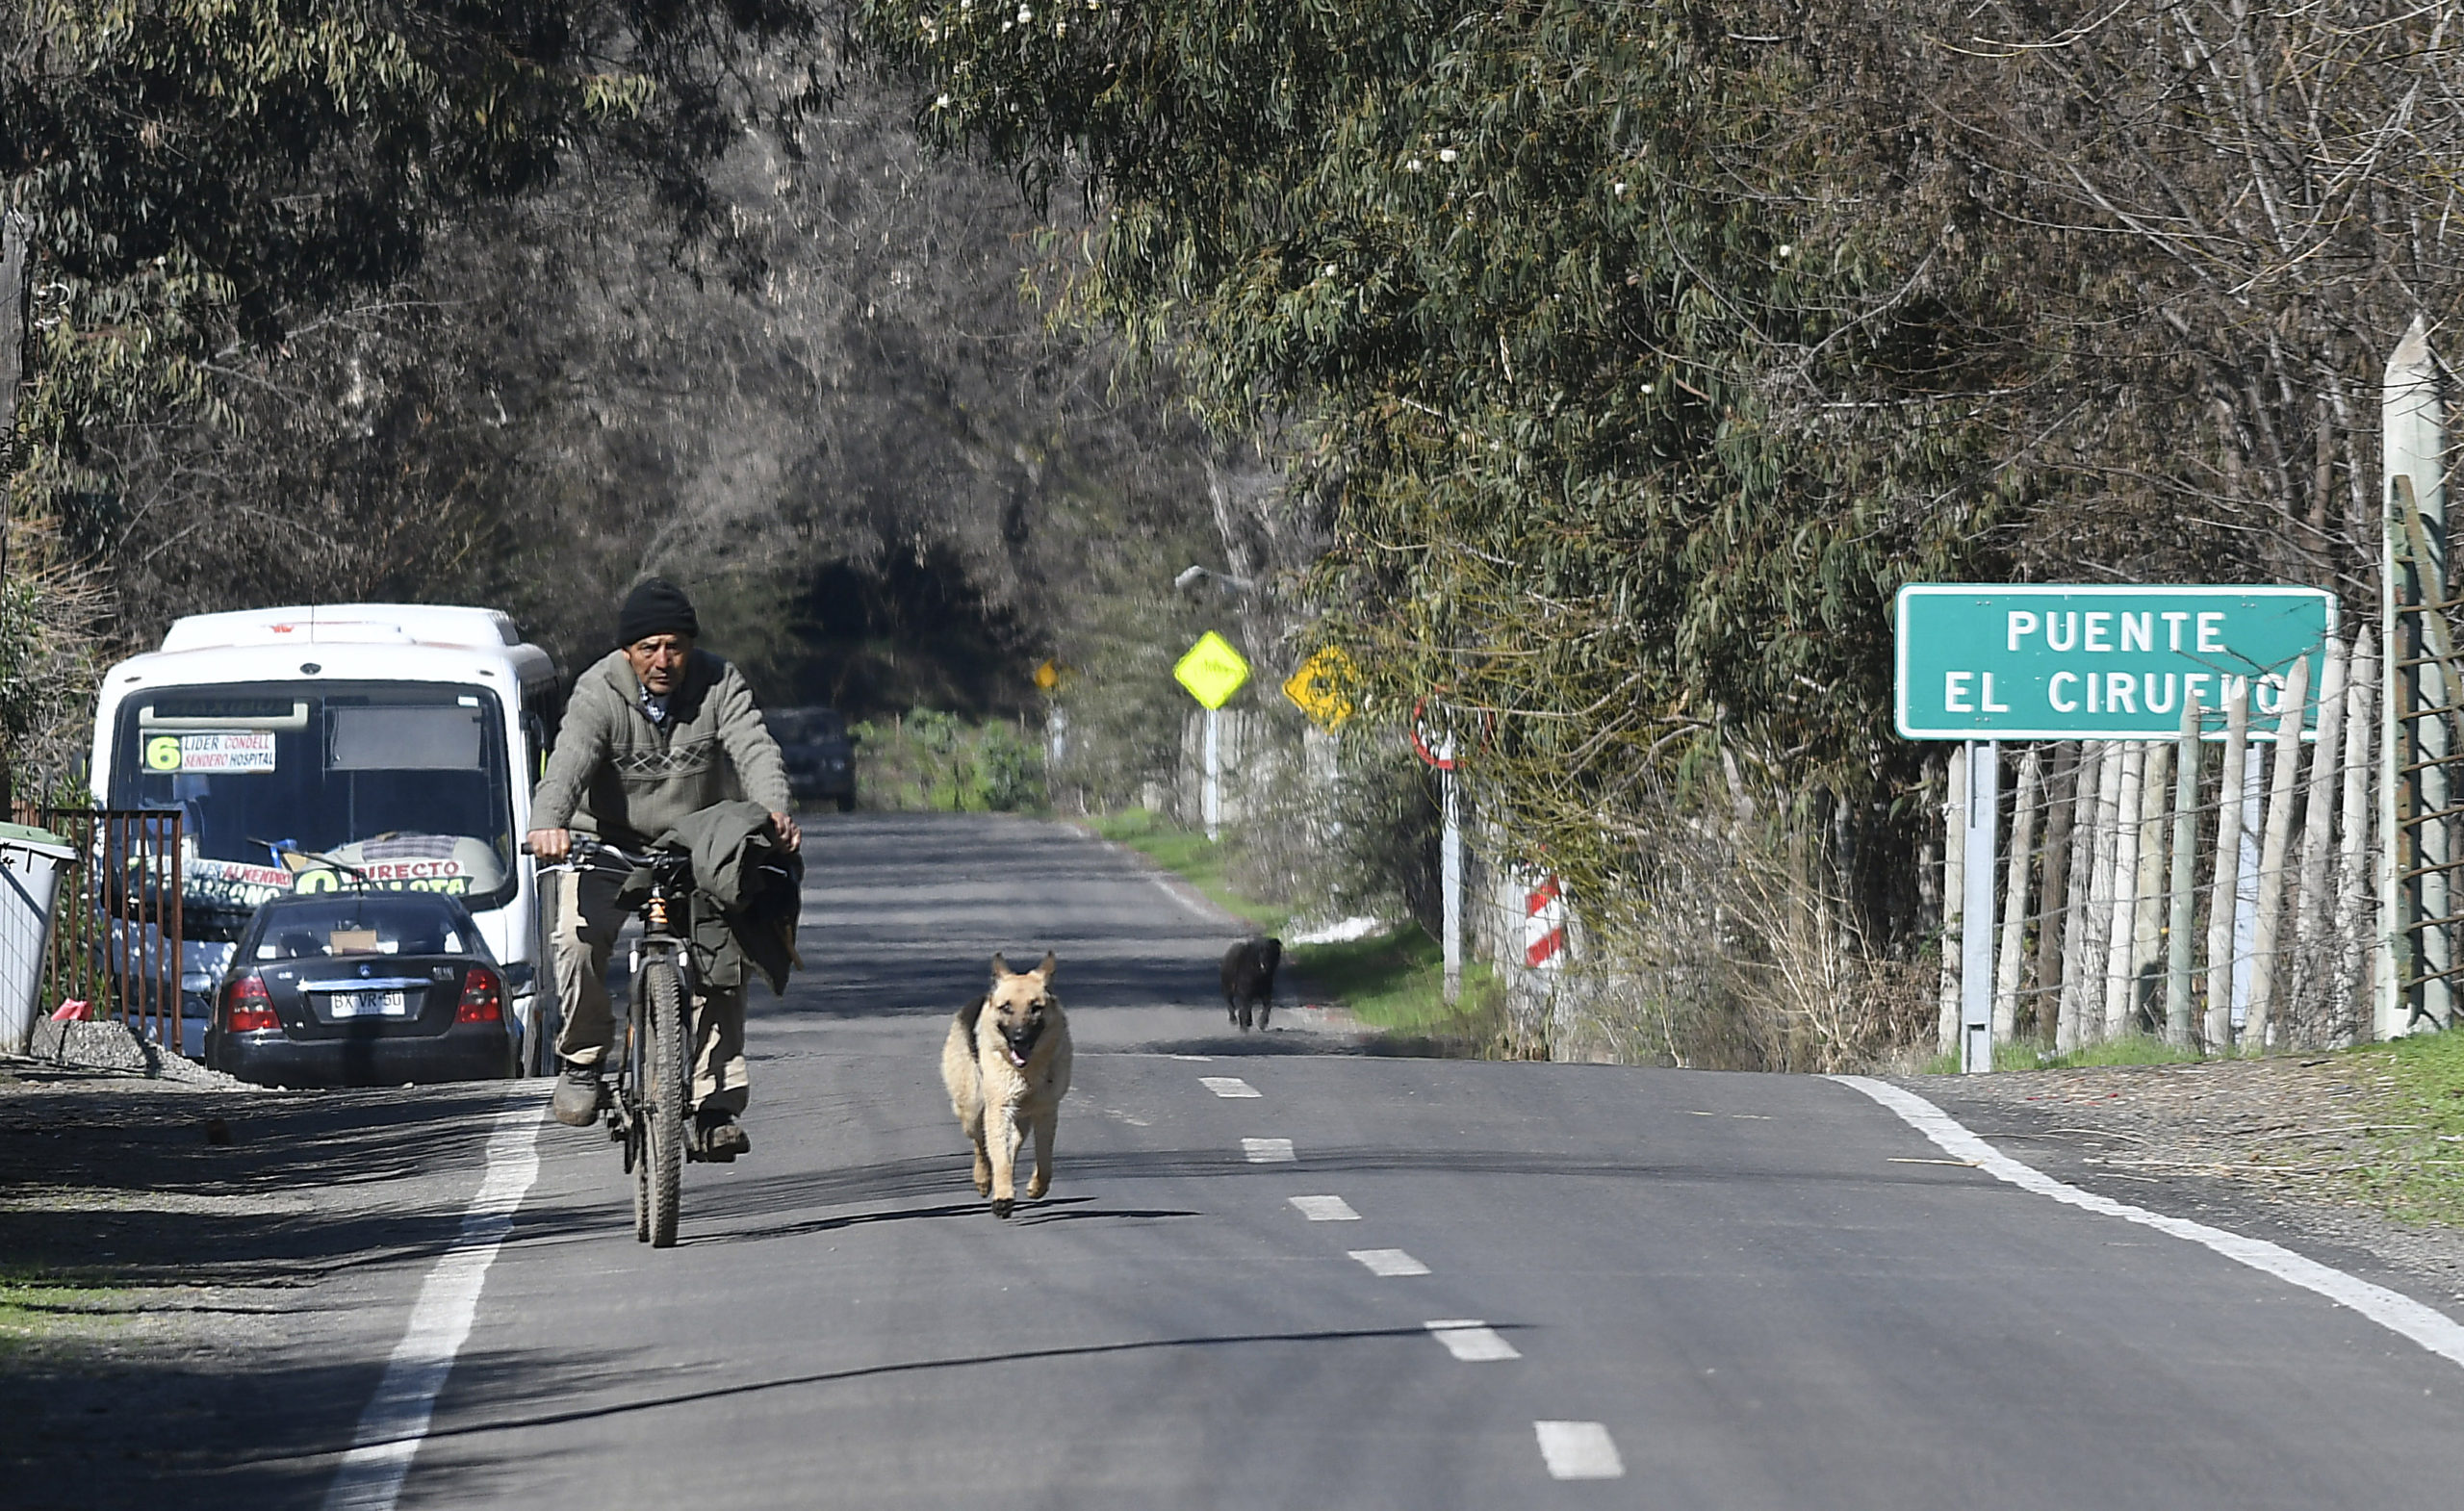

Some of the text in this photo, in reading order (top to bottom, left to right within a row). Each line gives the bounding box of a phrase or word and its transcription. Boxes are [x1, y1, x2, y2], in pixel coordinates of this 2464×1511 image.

[2007, 610, 2227, 653] PUENTE
[1944, 671, 2011, 713] EL
[146, 735, 181, 771] 6
[184, 734, 270, 751] LIDER CONDELL
[184, 753, 273, 768] SENDERO HOSPITAL
